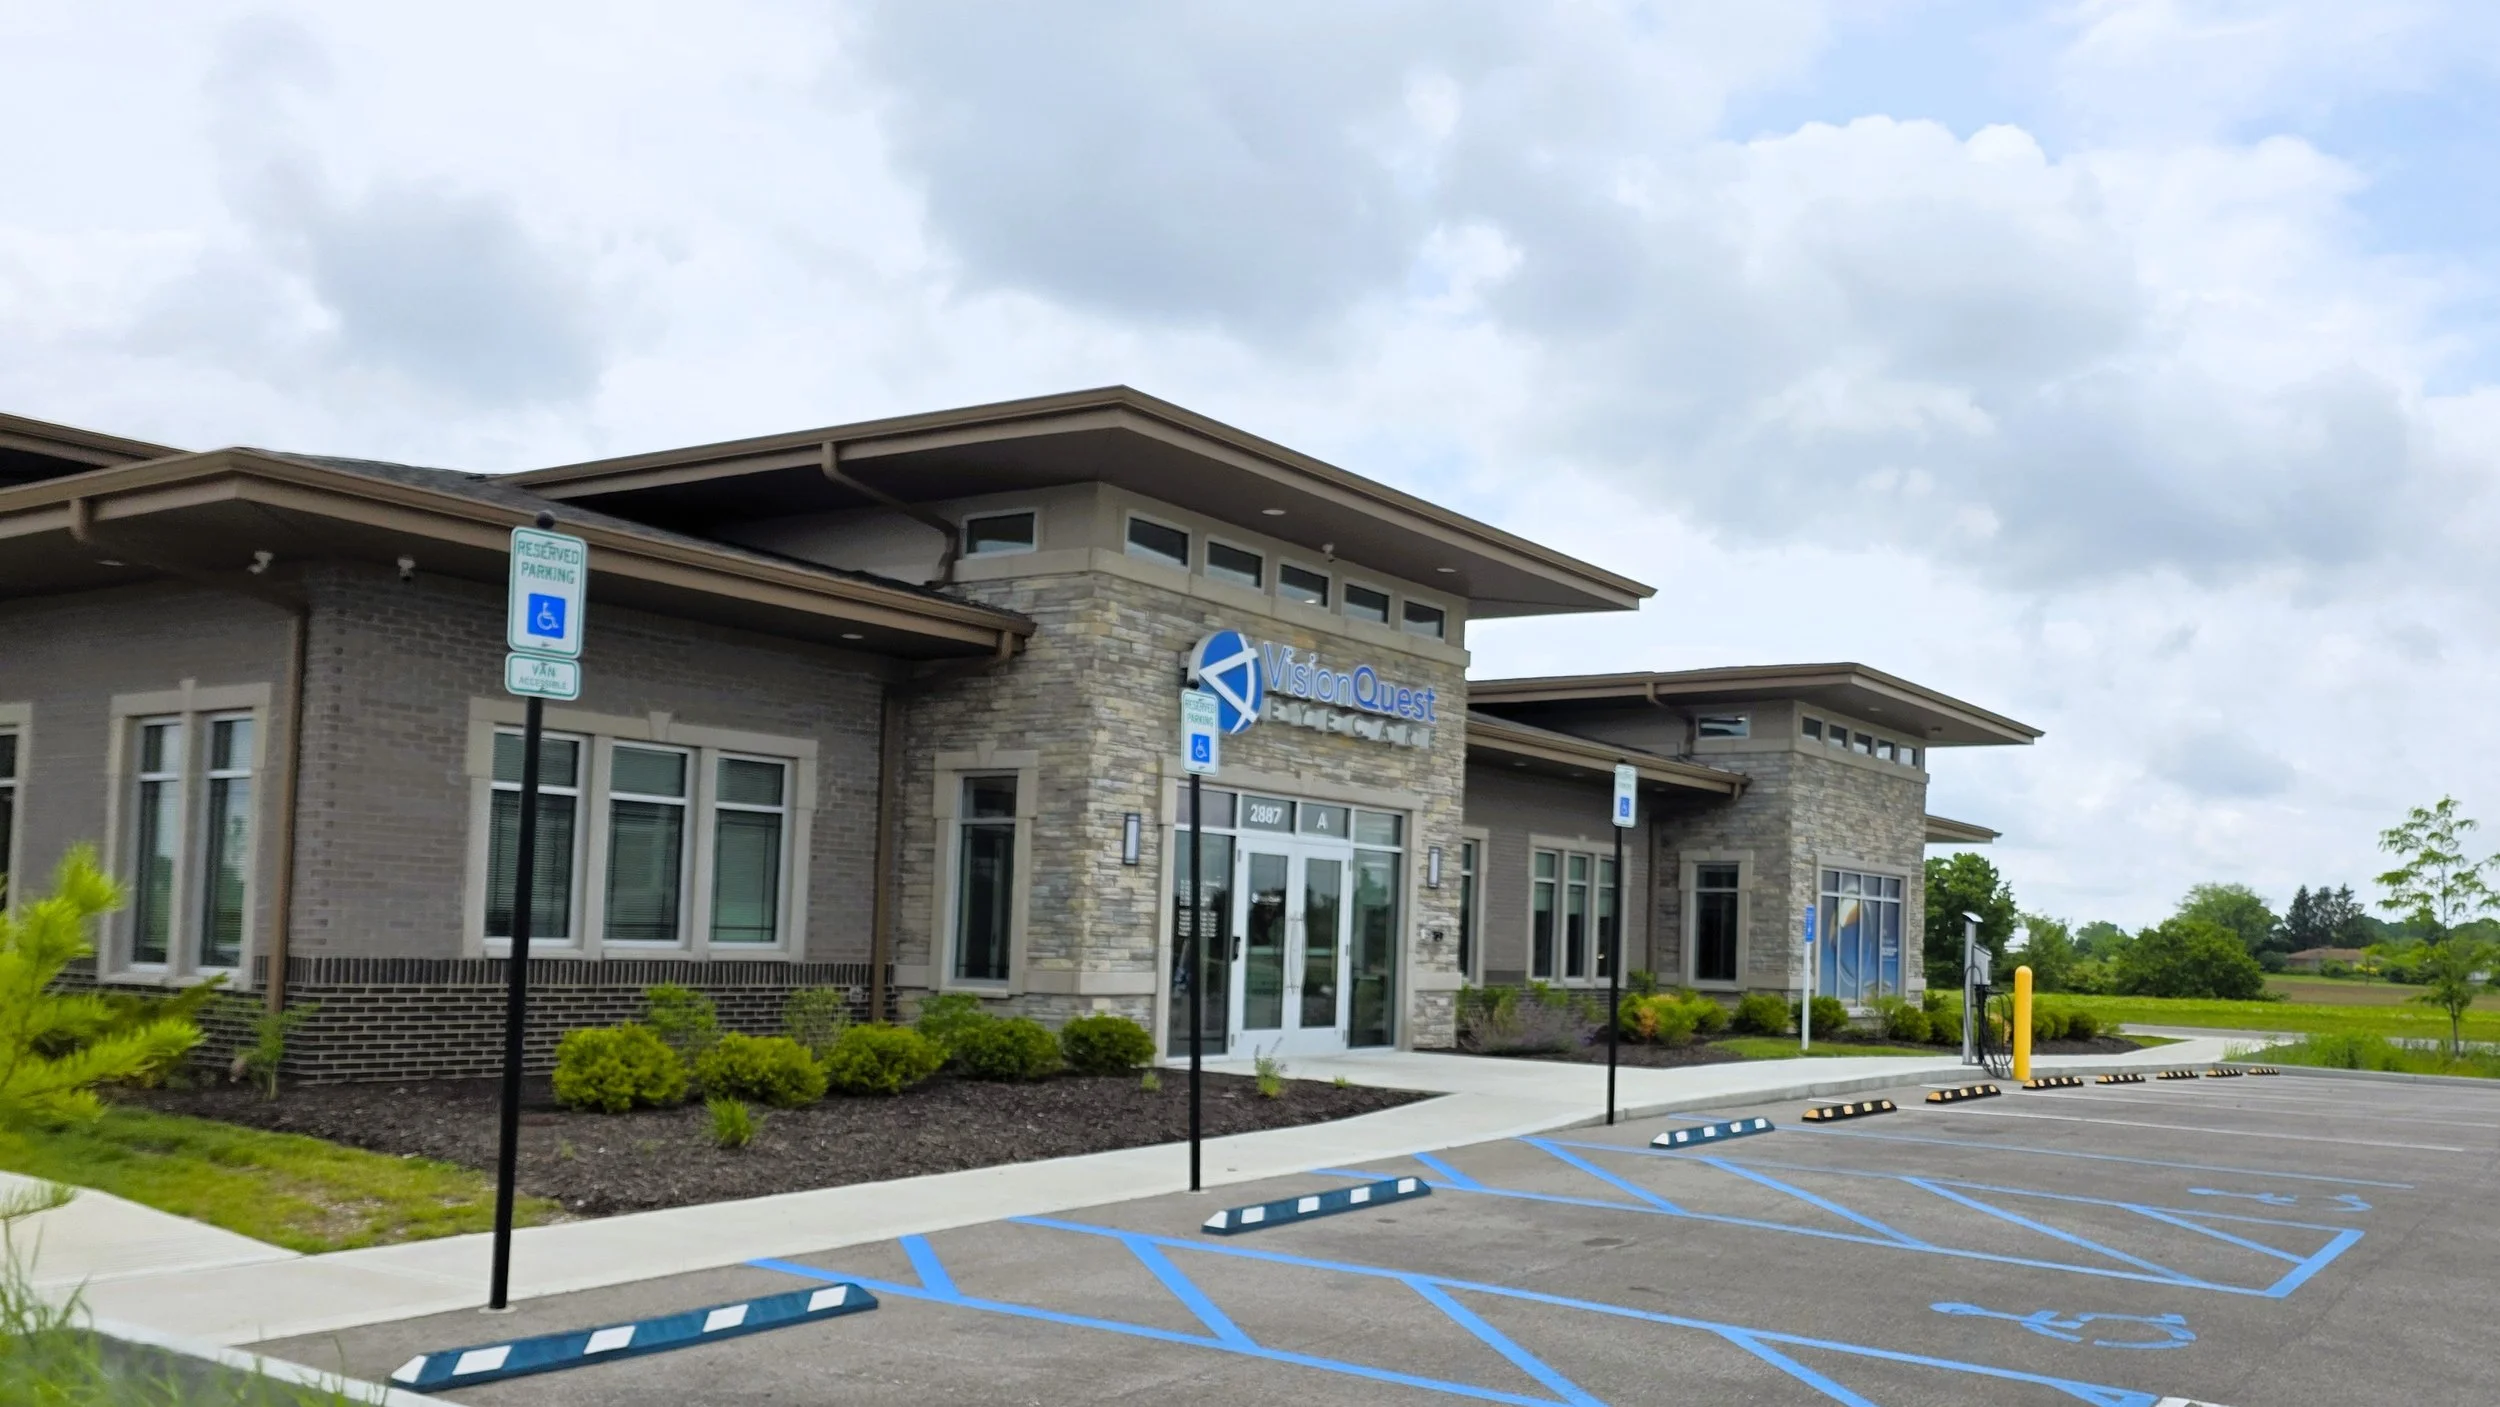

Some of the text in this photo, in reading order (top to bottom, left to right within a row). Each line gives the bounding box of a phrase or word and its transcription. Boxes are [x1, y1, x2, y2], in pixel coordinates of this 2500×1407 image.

[517, 540, 581, 565] RESERVED
[521, 561, 576, 585] PARKING
[532, 662, 556, 678] VAN
[519, 676, 567, 690] ACCESSIBLE
[1263, 641, 1437, 724] VisionQuest
[1187, 712, 1214, 727] PARKING
[1267, 698, 1437, 748] EYECARE
[1250, 803, 1329, 830] 2887 A
